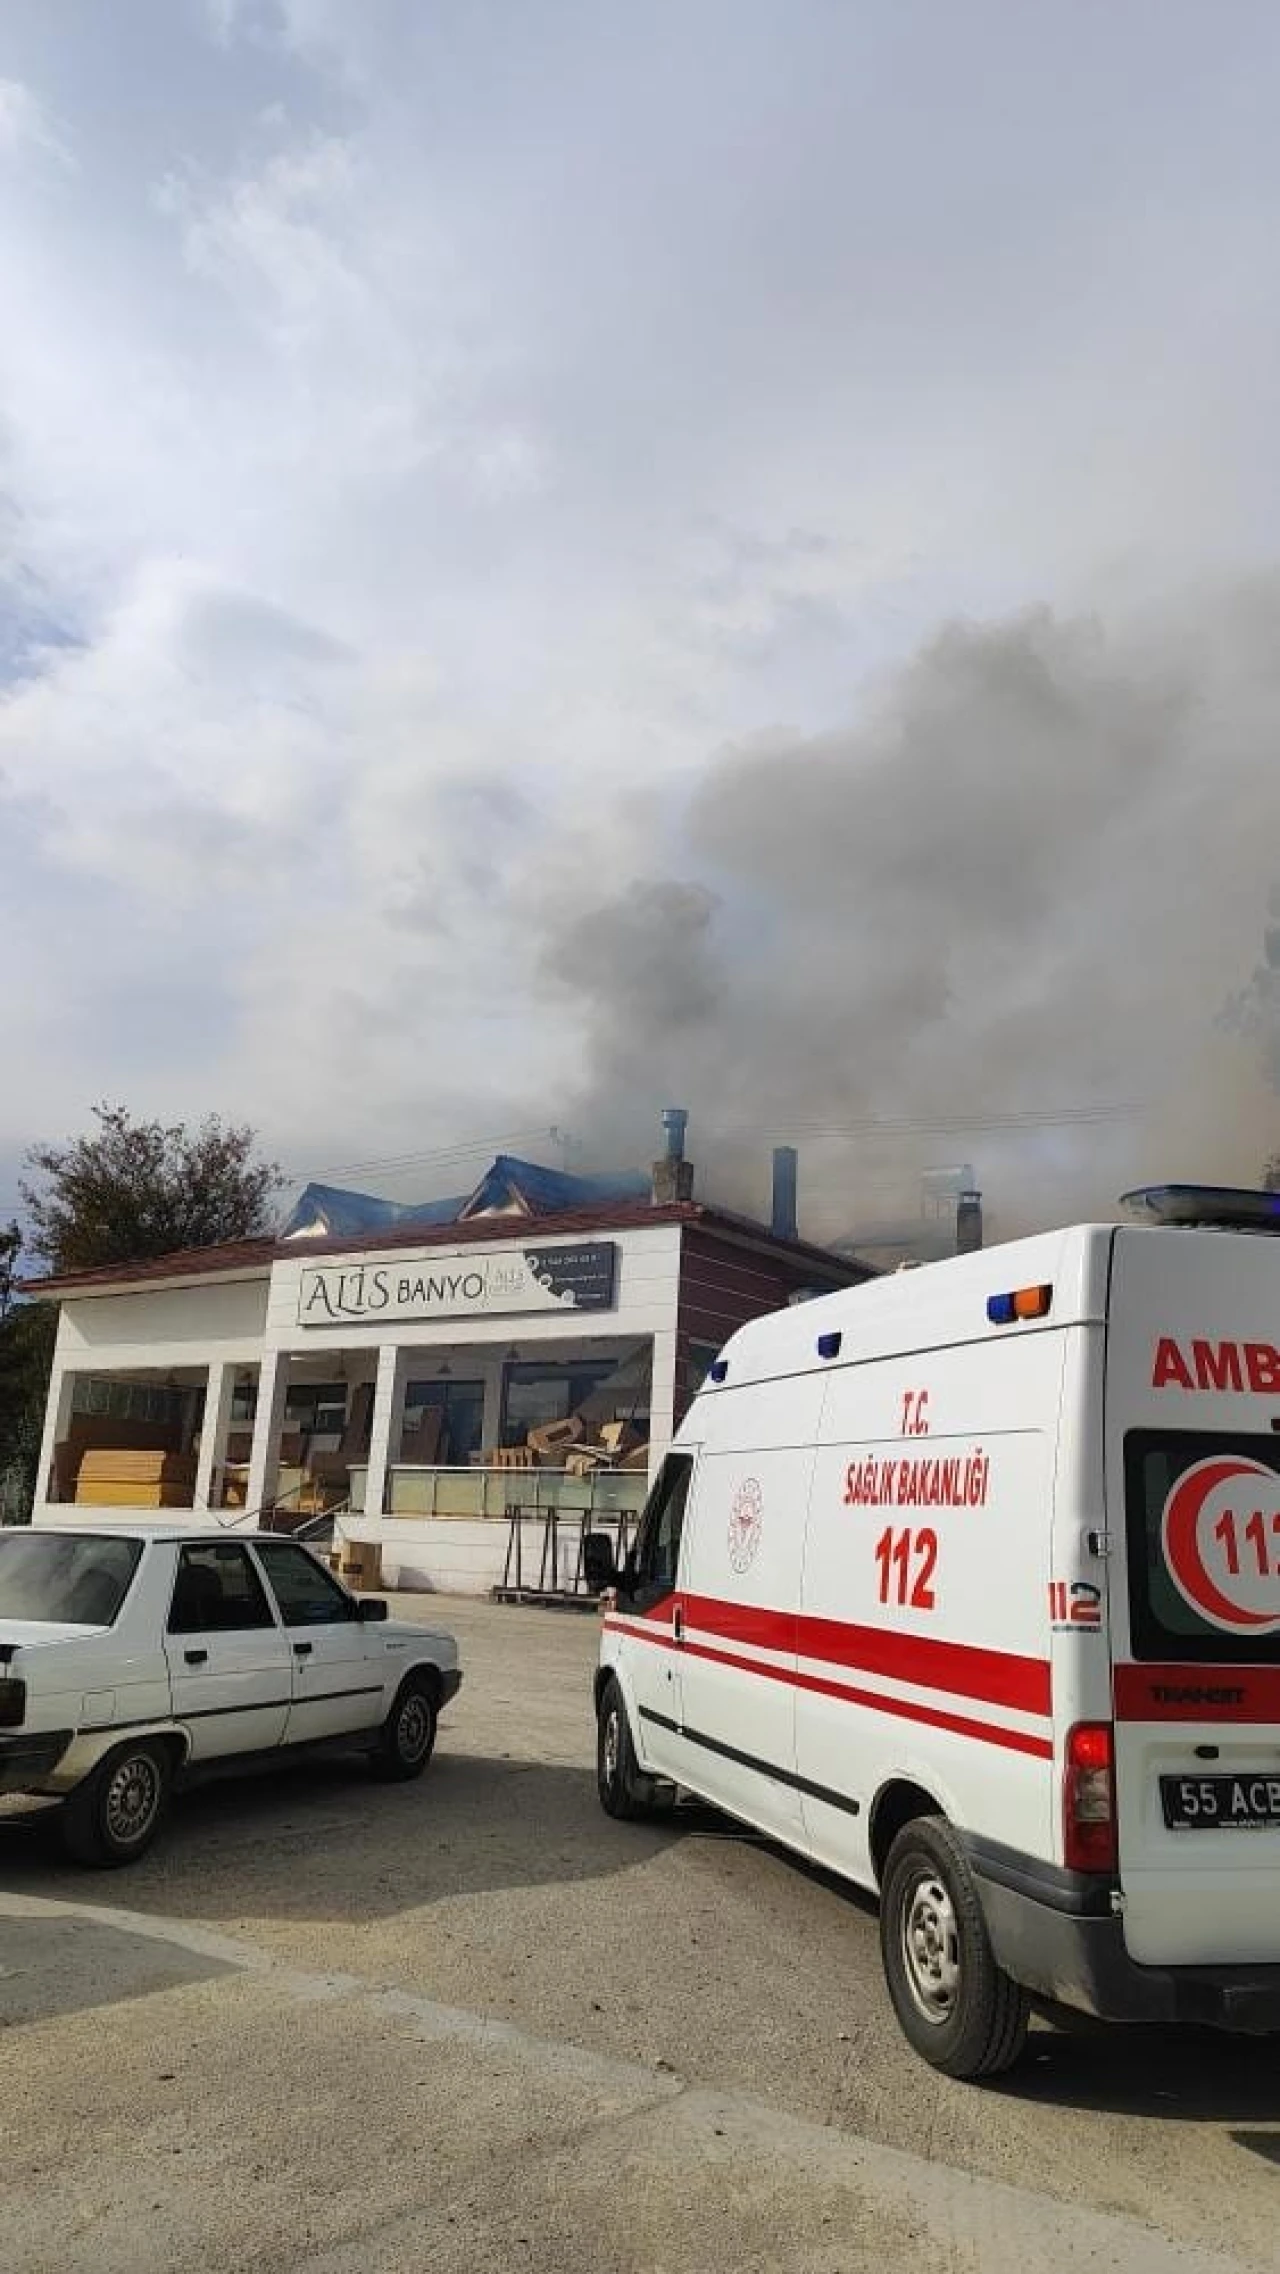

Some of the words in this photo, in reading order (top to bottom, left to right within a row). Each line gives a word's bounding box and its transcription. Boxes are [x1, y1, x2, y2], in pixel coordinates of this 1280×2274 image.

[397, 1272, 484, 1304] BANYO
[1152, 1337, 1280, 1392] AMB
[844, 1453, 897, 1506] SAĞLIK
[897, 1447, 990, 1506] BAKANLIĞI
[874, 1525, 938, 1610] 112
[1214, 1509, 1280, 1577] 11
[1047, 1582, 1101, 1622] 112
[1180, 1782, 1218, 1815] 55
